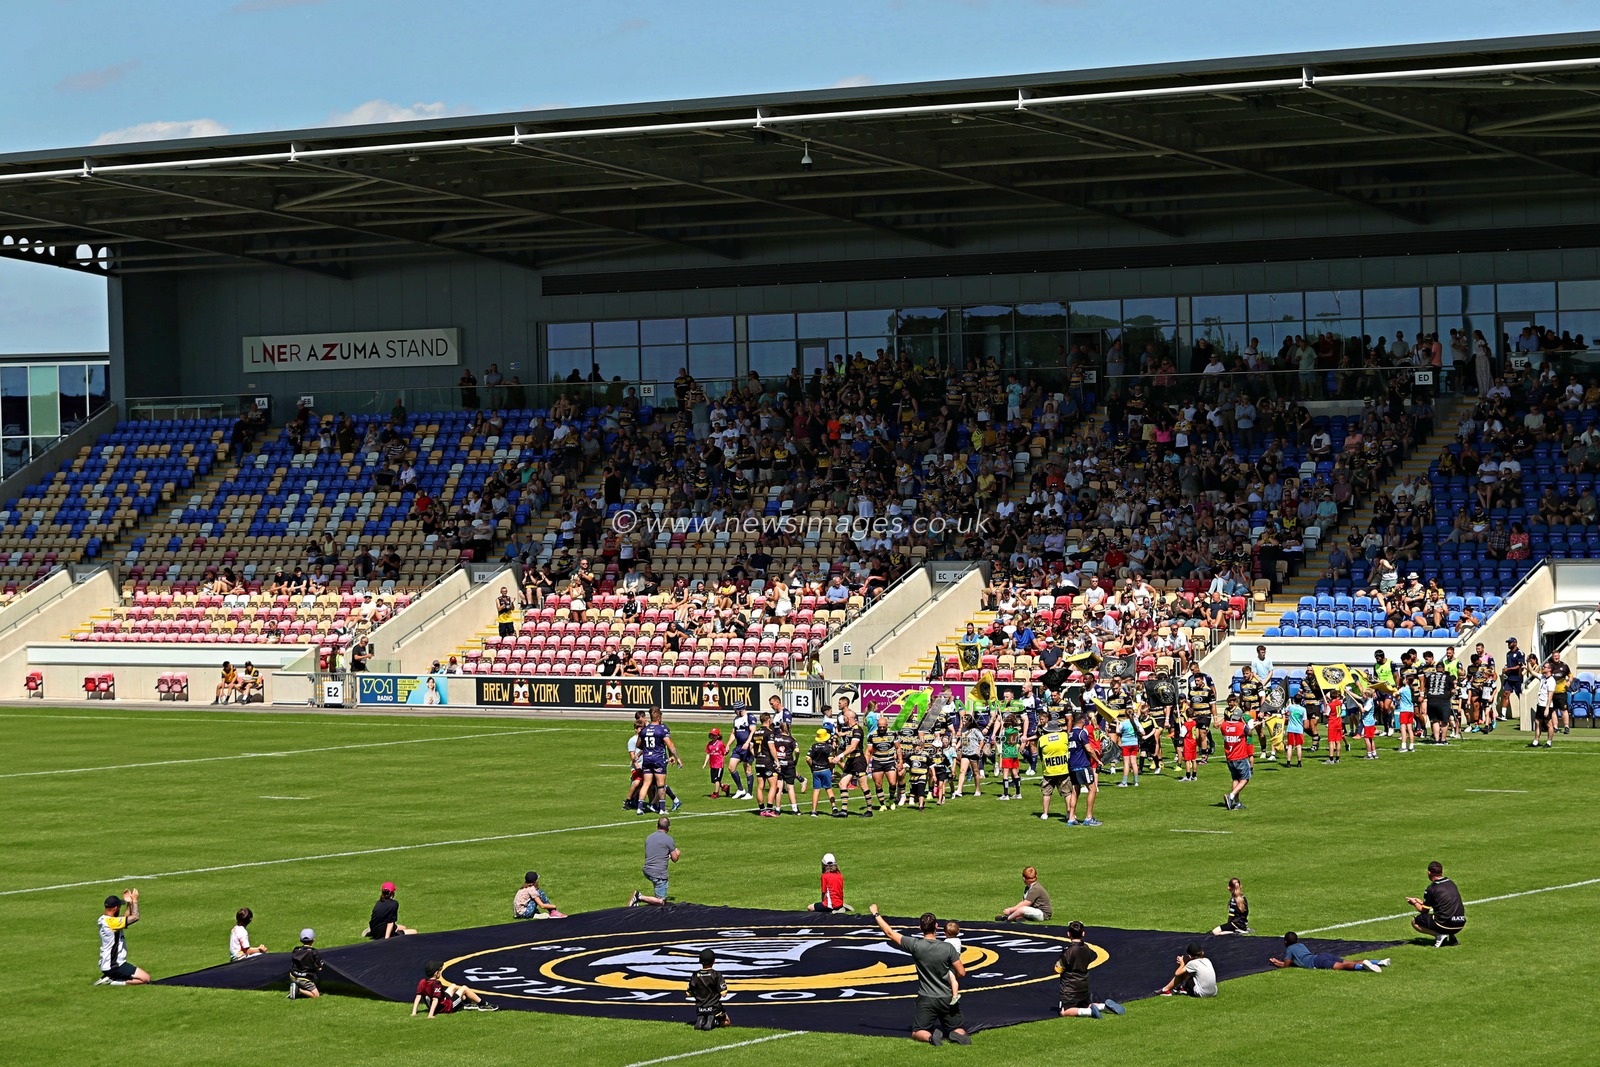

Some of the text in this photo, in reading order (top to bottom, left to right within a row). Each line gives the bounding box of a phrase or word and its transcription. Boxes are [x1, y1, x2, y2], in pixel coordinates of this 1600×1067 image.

[251, 338, 449, 366] LNER AZUMA STAND
[1418, 374, 1430, 382] ED
[327, 686, 339, 698] E2
[483, 682, 560, 703] BREW YORK
[574, 684, 654, 705] BREW YORK
[670, 685, 752, 706] BREW YORK
[795, 695, 809, 707] E3
[644, 736, 656, 748] 13
[755, 740, 762, 752] 7
[1045, 755, 1069, 767] MEDIA
[604, 988, 890, 1002] YOK
